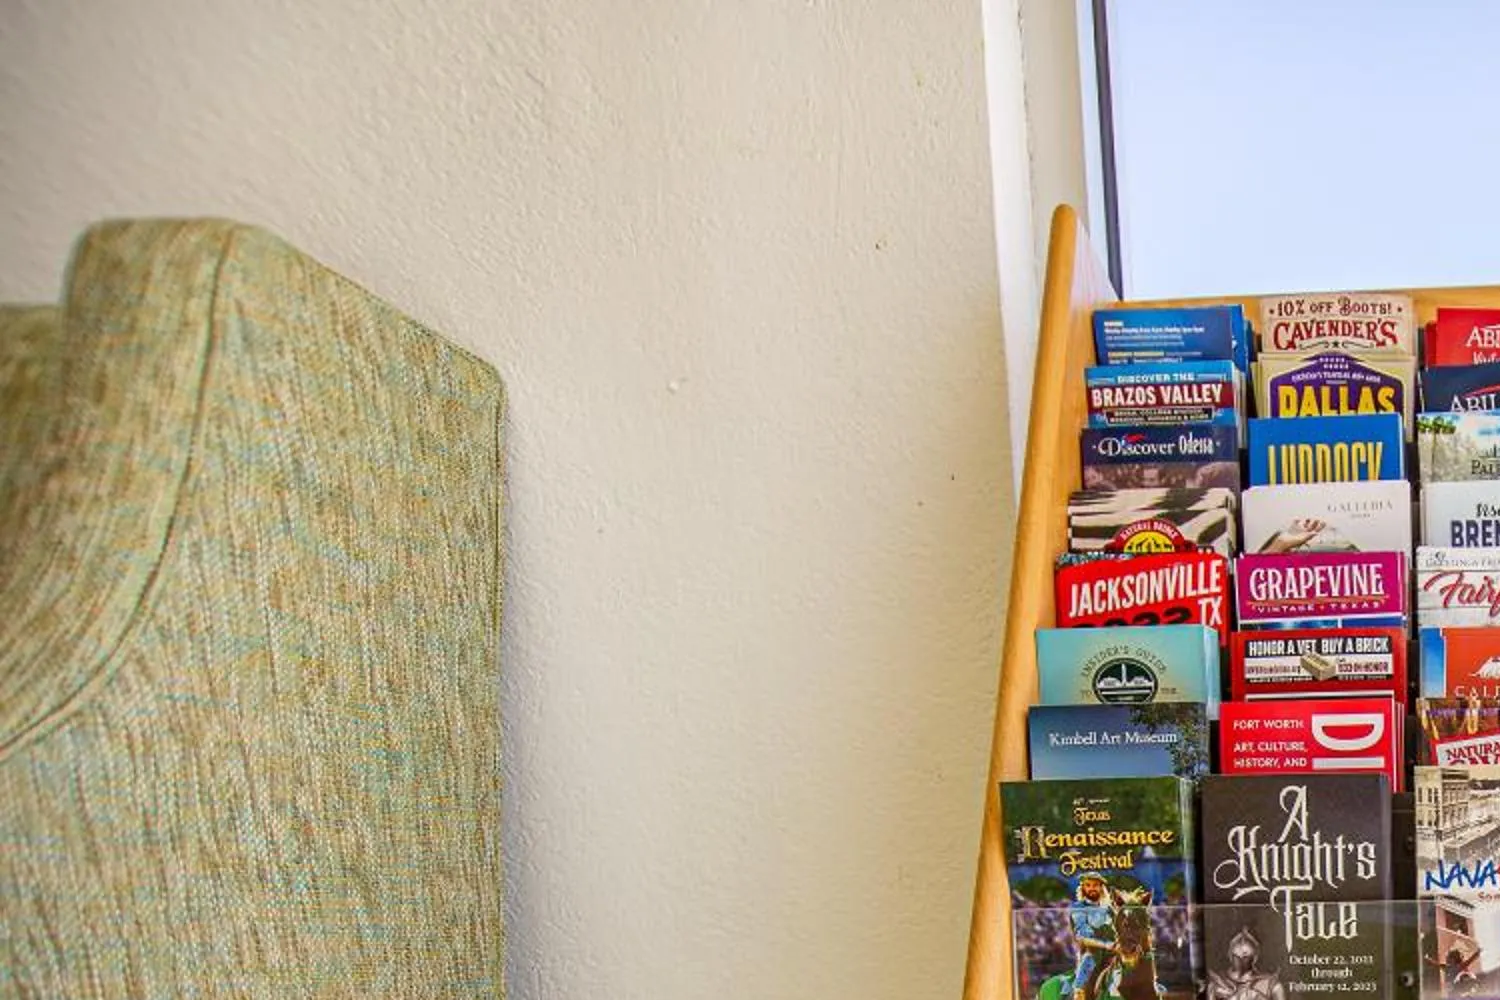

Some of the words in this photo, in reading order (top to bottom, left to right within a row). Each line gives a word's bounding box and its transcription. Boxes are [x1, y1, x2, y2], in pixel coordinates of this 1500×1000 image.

[1277, 300, 1304, 316] 10%
[1310, 302, 1333, 314] OFF
[1339, 297, 1392, 315] BOOTS!
[1273, 318, 1398, 350] CAVENDER'S
[1118, 374, 1171, 384] DISCOVER
[1174, 373, 1194, 382] THE
[1092, 386, 1157, 407] BRAZOS
[1160, 384, 1223, 405] VALLEY
[1278, 385, 1396, 418] DALLAS
[1098, 437, 1176, 457] Discover
[1178, 432, 1214, 455] Odessa
[1069, 559, 1223, 617] JACKSONVILLE
[1250, 563, 1385, 601] GRAPEVINE
[1197, 597, 1222, 626] TX
[1249, 640, 1285, 656] HONOR
[1287, 641, 1296, 655] A
[1321, 638, 1343, 653] BUY
[1345, 639, 1354, 653] A
[1355, 637, 1389, 653] BRICK
[1233, 720, 1260, 729] FORT
[1049, 731, 1097, 746] Kimbell
[1100, 732, 1121, 744] Art
[1124, 732, 1178, 744] Museum
[1284, 757, 1307, 767] AND
[1278, 785, 1309, 843] A
[1014, 825, 1174, 863] Renaissance
[1060, 849, 1134, 876] Festival
[1213, 825, 1377, 901] Knight's
